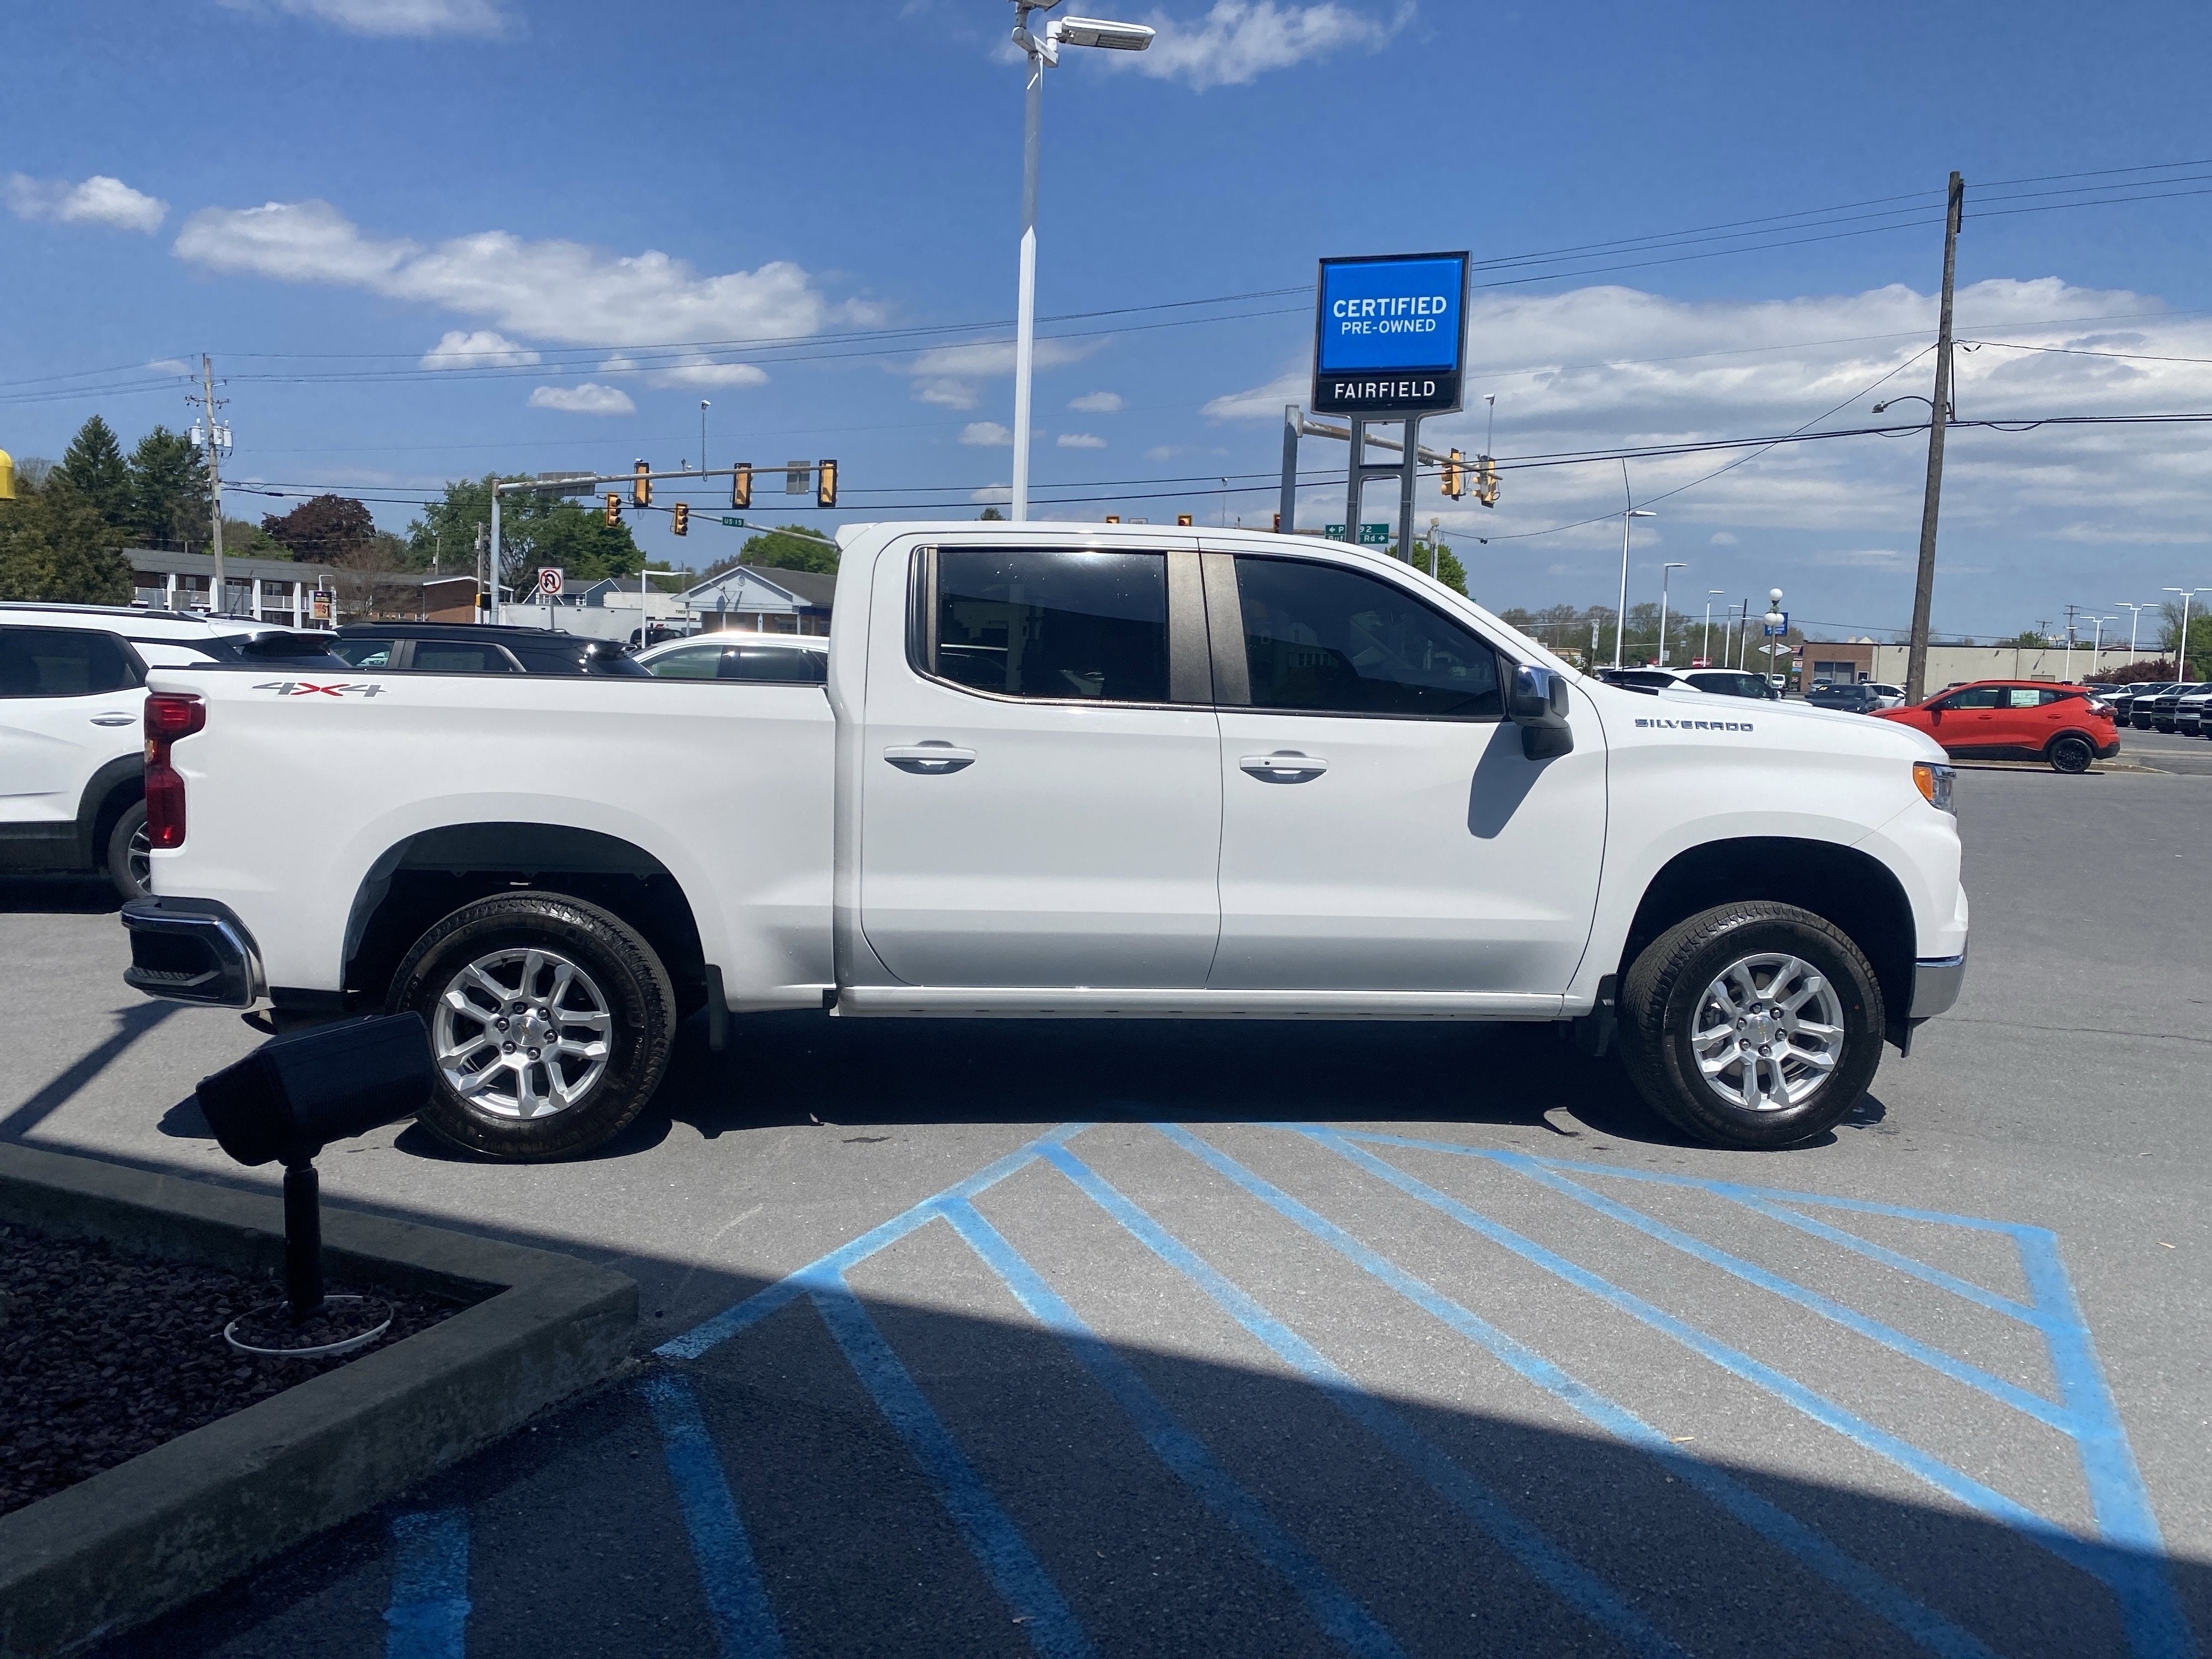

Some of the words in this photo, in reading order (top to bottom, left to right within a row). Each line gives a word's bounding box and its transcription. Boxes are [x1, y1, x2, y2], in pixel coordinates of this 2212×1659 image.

[1333, 296, 1447, 318] CERTIFIED
[1341, 319, 1436, 335] PRE-OWNED
[1334, 381, 1435, 399] FAIRFIELD
[252, 682, 389, 697] 4X4
[1635, 718, 1753, 731] SILVERADO
